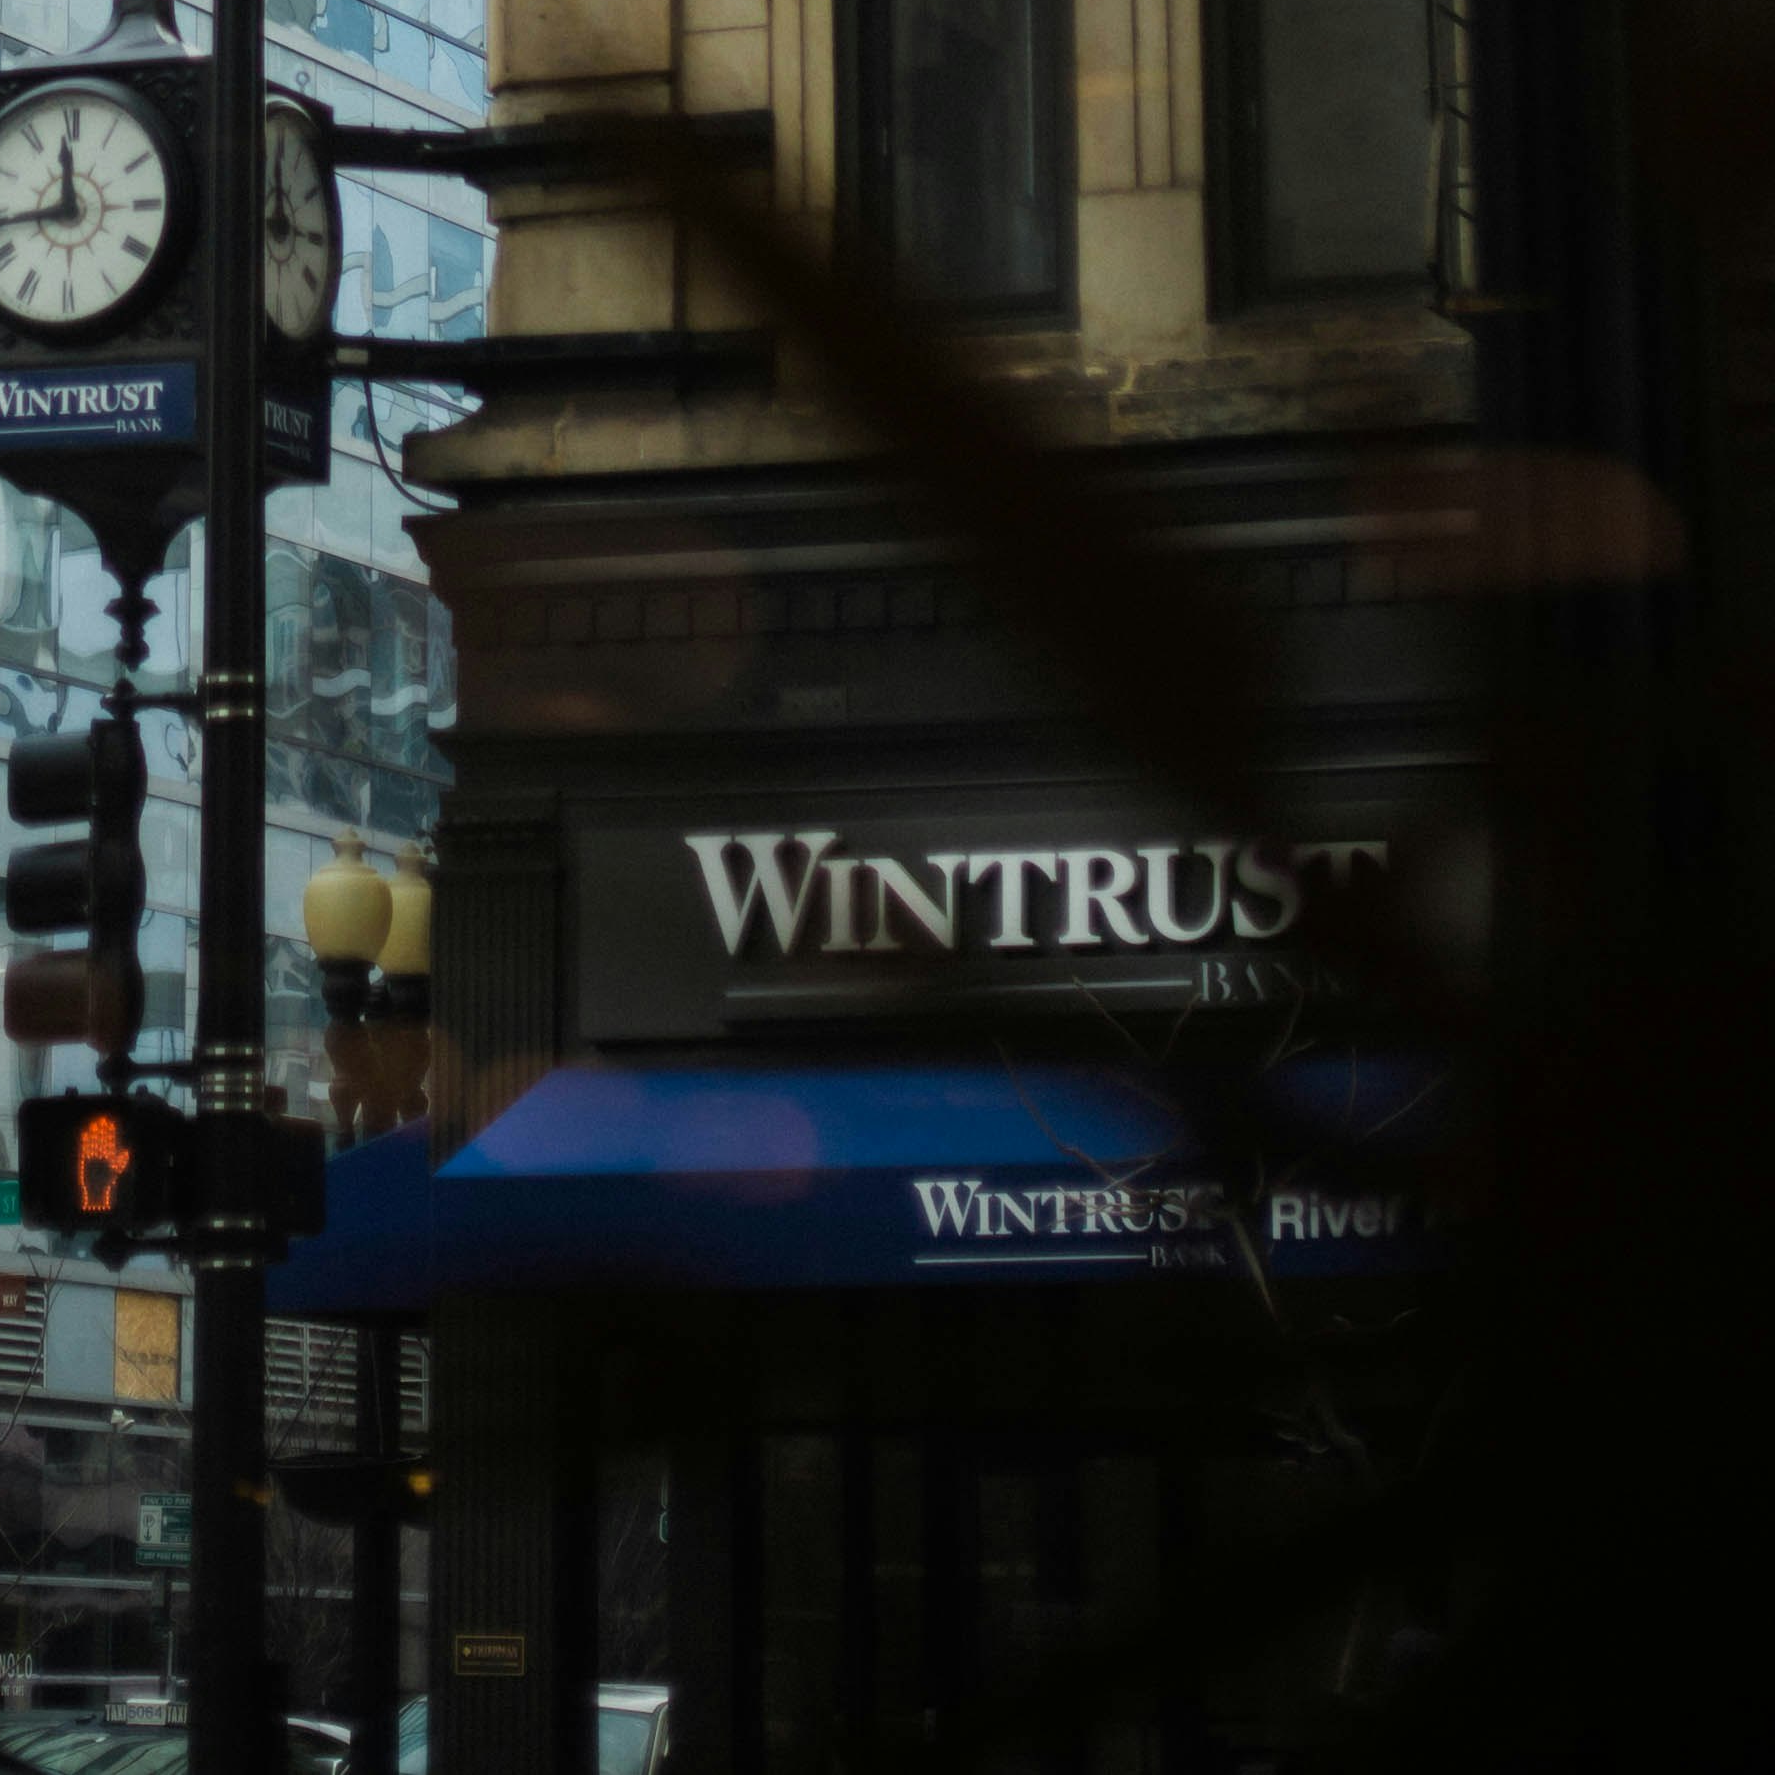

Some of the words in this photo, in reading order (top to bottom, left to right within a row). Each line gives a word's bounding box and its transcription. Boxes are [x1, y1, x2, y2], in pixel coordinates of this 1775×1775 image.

[116, 416, 162, 435] BANK
[264, 400, 312, 440] TRUST
[3, 1194, 17, 1213] ST
[915, 1180, 1227, 1239] WINTRUST
[1269, 1191, 1405, 1242] River
[2, 1293, 19, 1307] WAY
[104, 1704, 126, 1722] TAXI
[167, 1704, 188, 1724] TAXI
